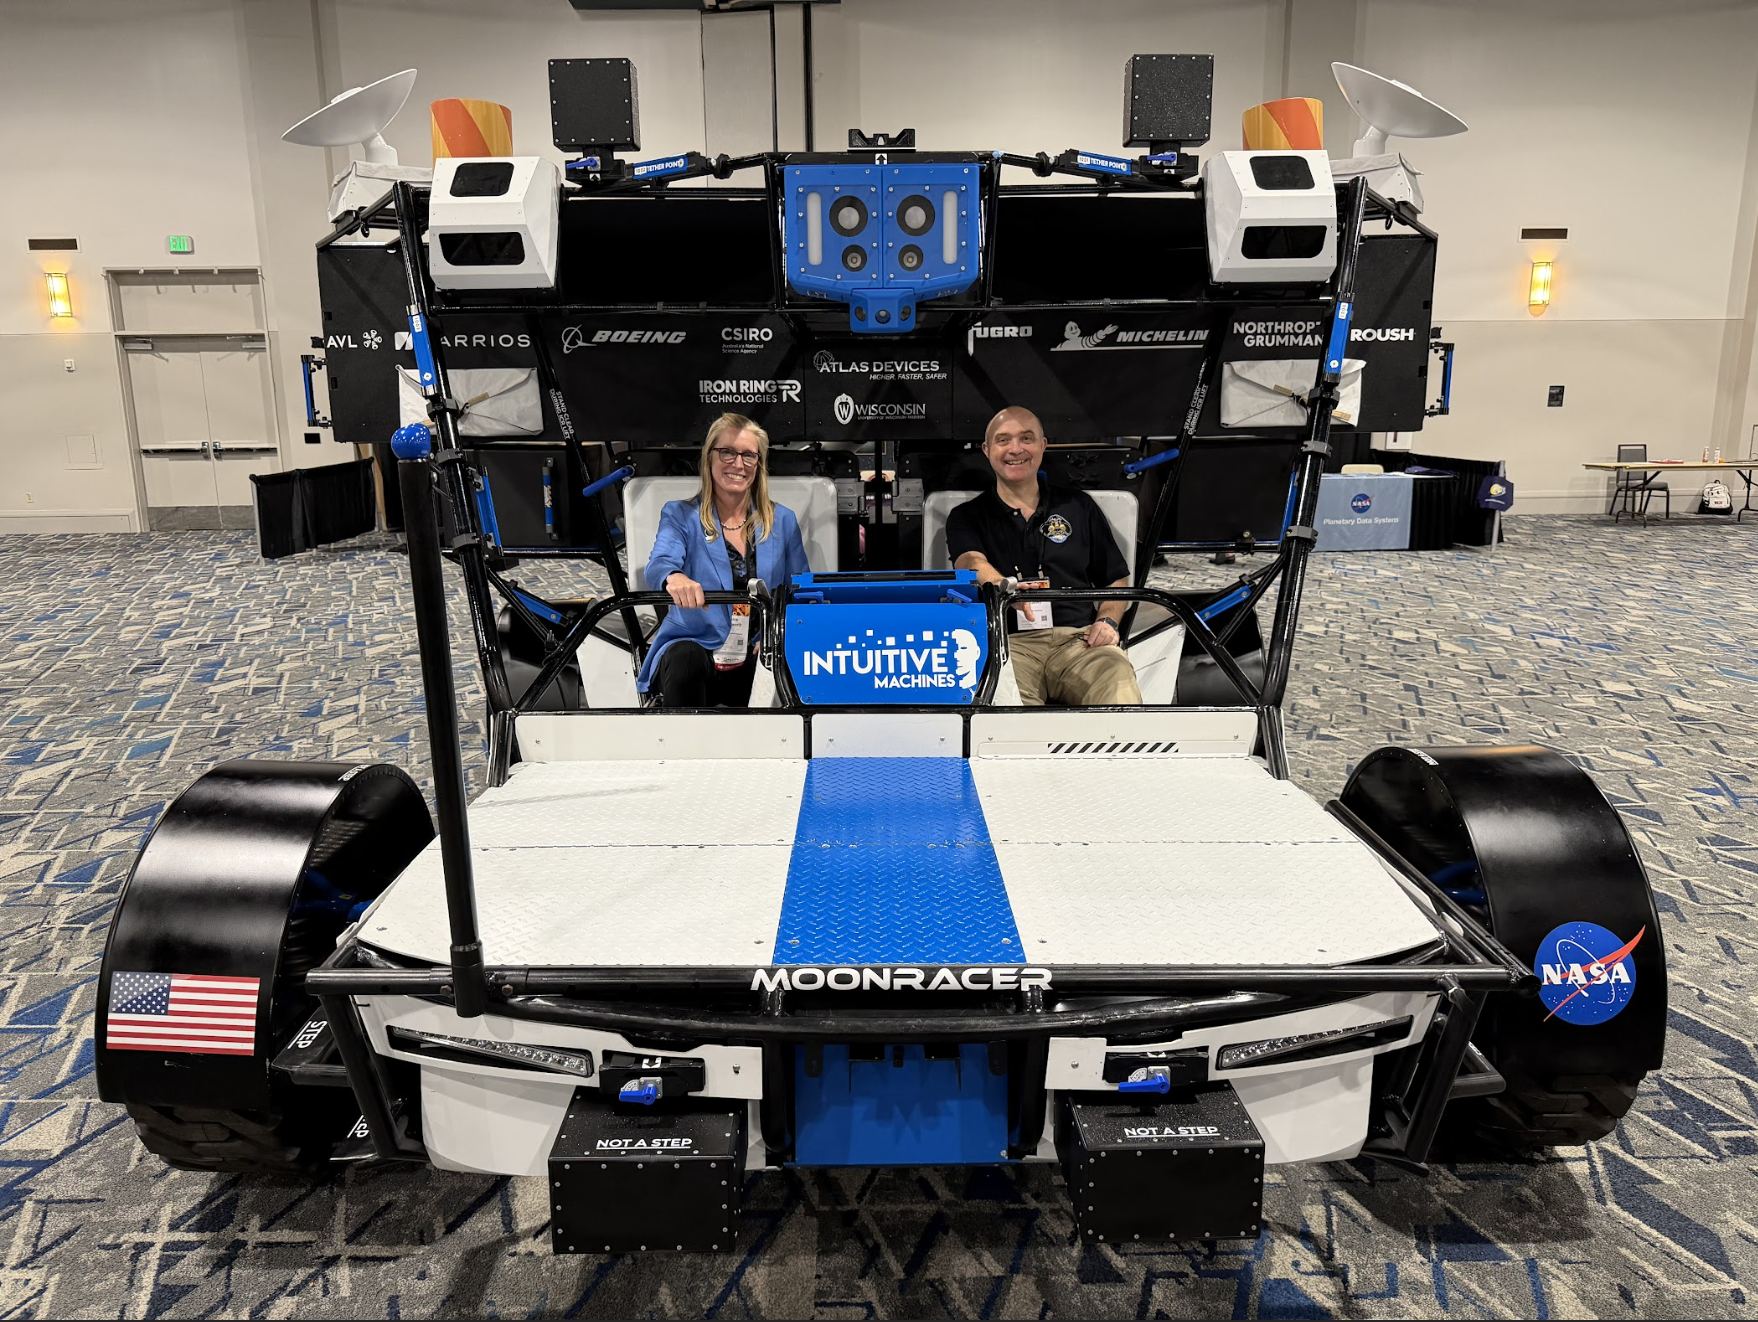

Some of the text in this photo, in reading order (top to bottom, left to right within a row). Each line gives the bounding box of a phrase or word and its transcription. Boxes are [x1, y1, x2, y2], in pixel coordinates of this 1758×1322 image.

[170, 235, 188, 251] EXIT
[721, 327, 773, 342] CSIRO
[1233, 321, 1316, 334] NORTHROP
[326, 335, 358, 348] AVL
[440, 334, 531, 348] ARRIOS
[591, 330, 687, 344] BOEING
[1116, 329, 1210, 343] MICHELIN
[1244, 334, 1324, 347] GRUMMAN
[1350, 328, 1415, 342] ROUSH
[819, 360, 940, 373] ATLAS DEVICES
[925, 372, 947, 380] SAFER
[699, 380, 777, 393] IRON RING
[556, 391, 568, 412] STAND
[699, 394, 778, 403] TECHNOLOGIES
[855, 403, 926, 416] WISCONSIN
[1323, 518, 1355, 526] Planetary
[1373, 517, 1399, 525] System
[803, 648, 948, 676] INTUITIVE
[874, 674, 956, 689] MACHINES
[750, 967, 1053, 991] MOONRACER
[1541, 962, 1632, 985] NASA
[296, 1020, 327, 1049] STEP
[1123, 1126, 1219, 1136] NOT A STEP
[597, 1138, 693, 1148] NOT A STEP
